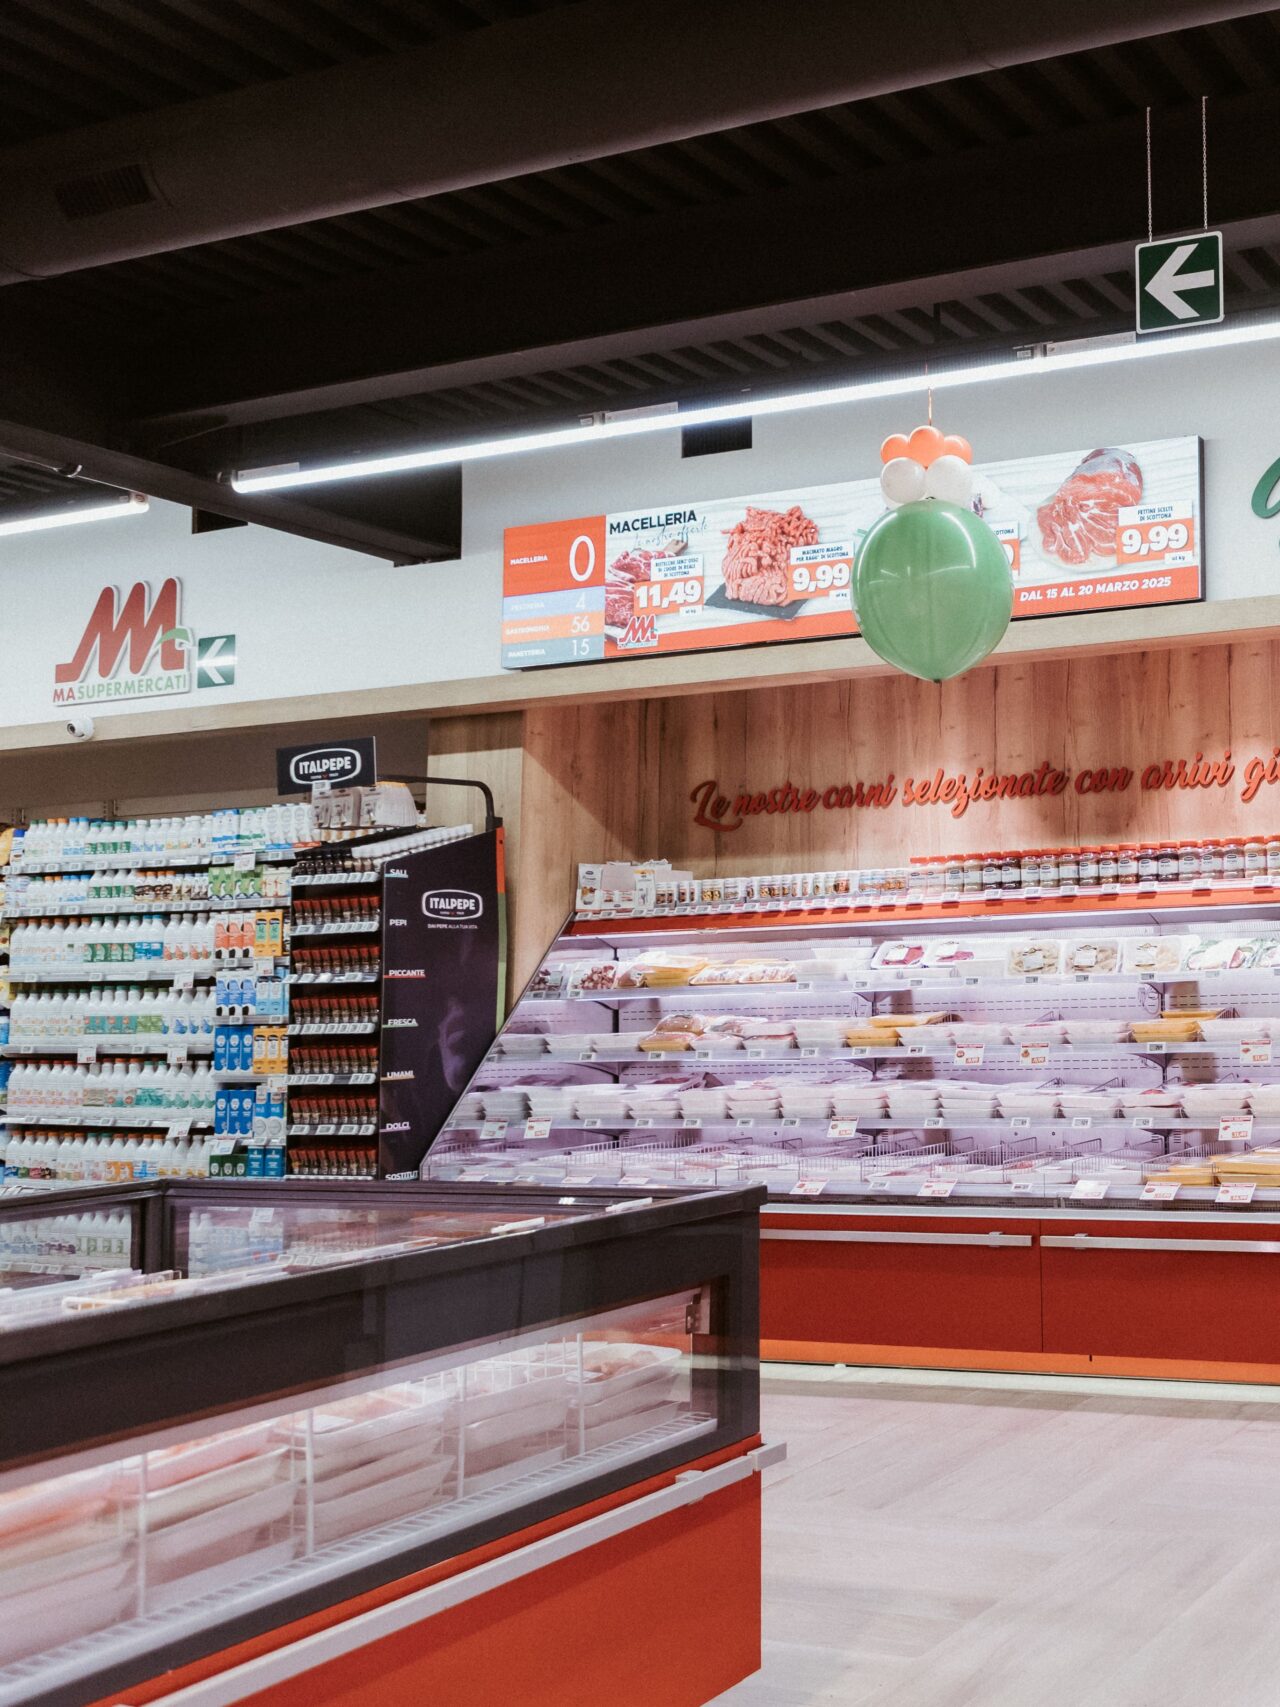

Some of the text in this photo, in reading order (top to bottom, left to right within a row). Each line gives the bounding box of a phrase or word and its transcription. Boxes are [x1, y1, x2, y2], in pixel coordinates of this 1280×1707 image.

[609, 510, 698, 536] MACELLERIA
[1121, 523, 1189, 556] 9,99
[569, 535, 596, 582] 0
[792, 563, 850, 592] 9,99
[635, 580, 702, 609] 11,49
[1020, 576, 1172, 601] DAL 15 AL 20 MARZO 2025
[575, 592, 587, 610] 4
[571, 616, 590, 633] 56
[572, 639, 590, 656] 15
[299, 756, 352, 775] ITALPEPE
[690, 780, 744, 832] Le
[732, 780, 822, 820] nostre
[822, 774, 897, 812] carni
[901, 760, 1069, 819] selezionate
[1074, 764, 1132, 796] con
[1141, 750, 1237, 791] arrivi
[429, 897, 476, 911] ITALPEPE
[389, 969, 425, 977] PICCANTE
[387, 1070, 414, 1079] UMAMI
[386, 1122, 410, 1130] DOLCI
